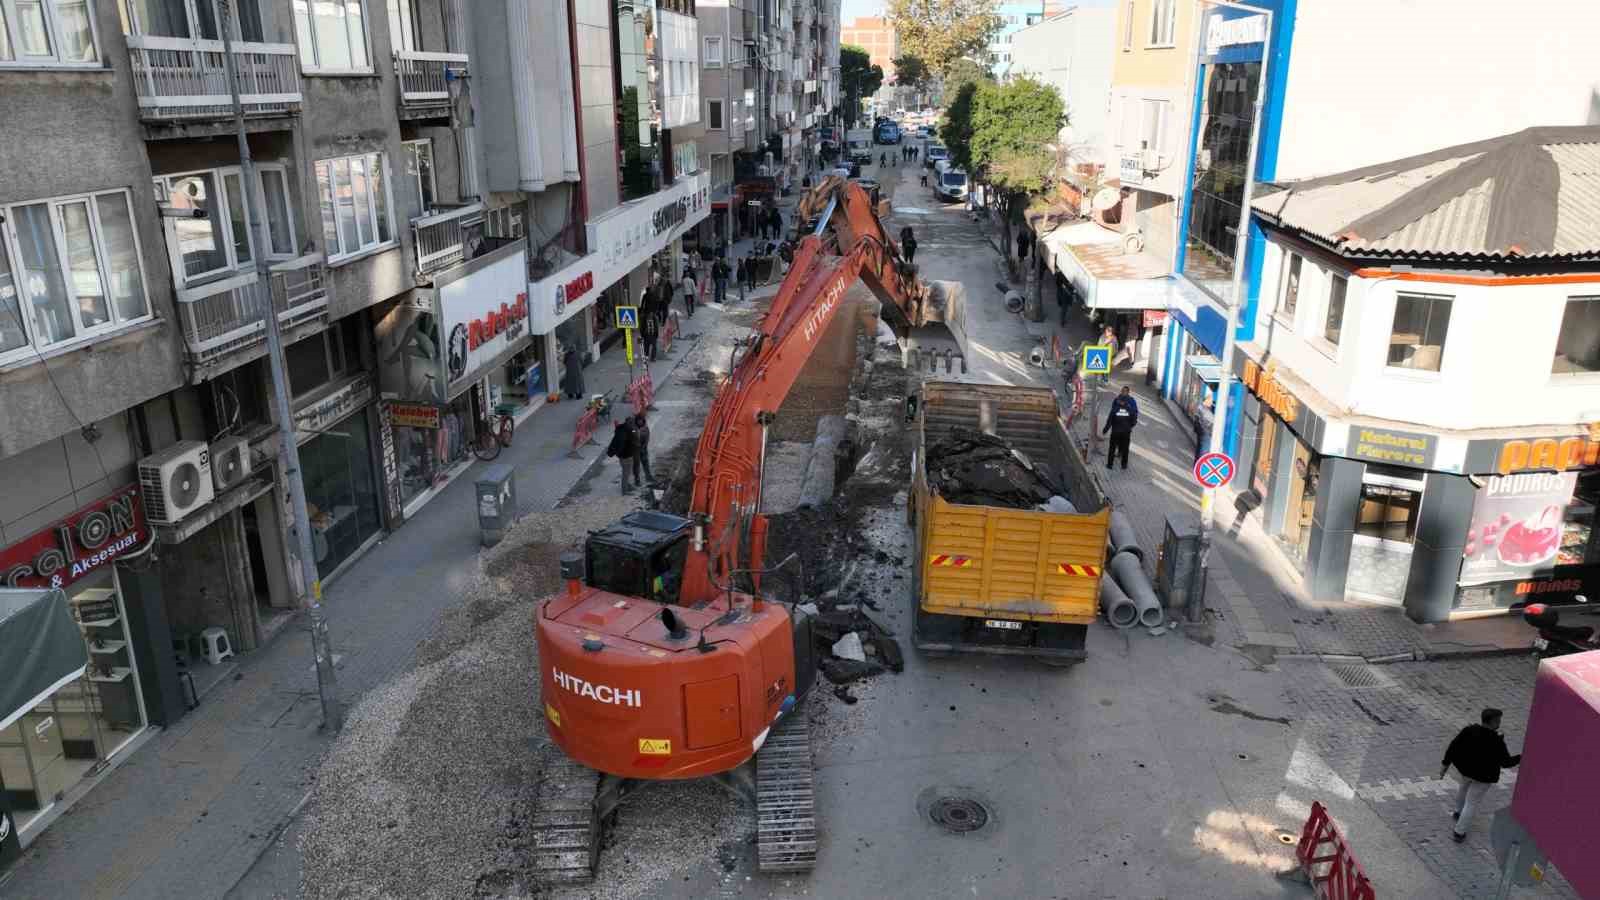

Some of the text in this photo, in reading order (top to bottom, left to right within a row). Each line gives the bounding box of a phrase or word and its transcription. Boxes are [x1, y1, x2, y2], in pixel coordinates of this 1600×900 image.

[803, 276, 845, 341] HITACHI
[72, 531, 138, 578] Aksesuar
[552, 666, 642, 708] HITACHI
